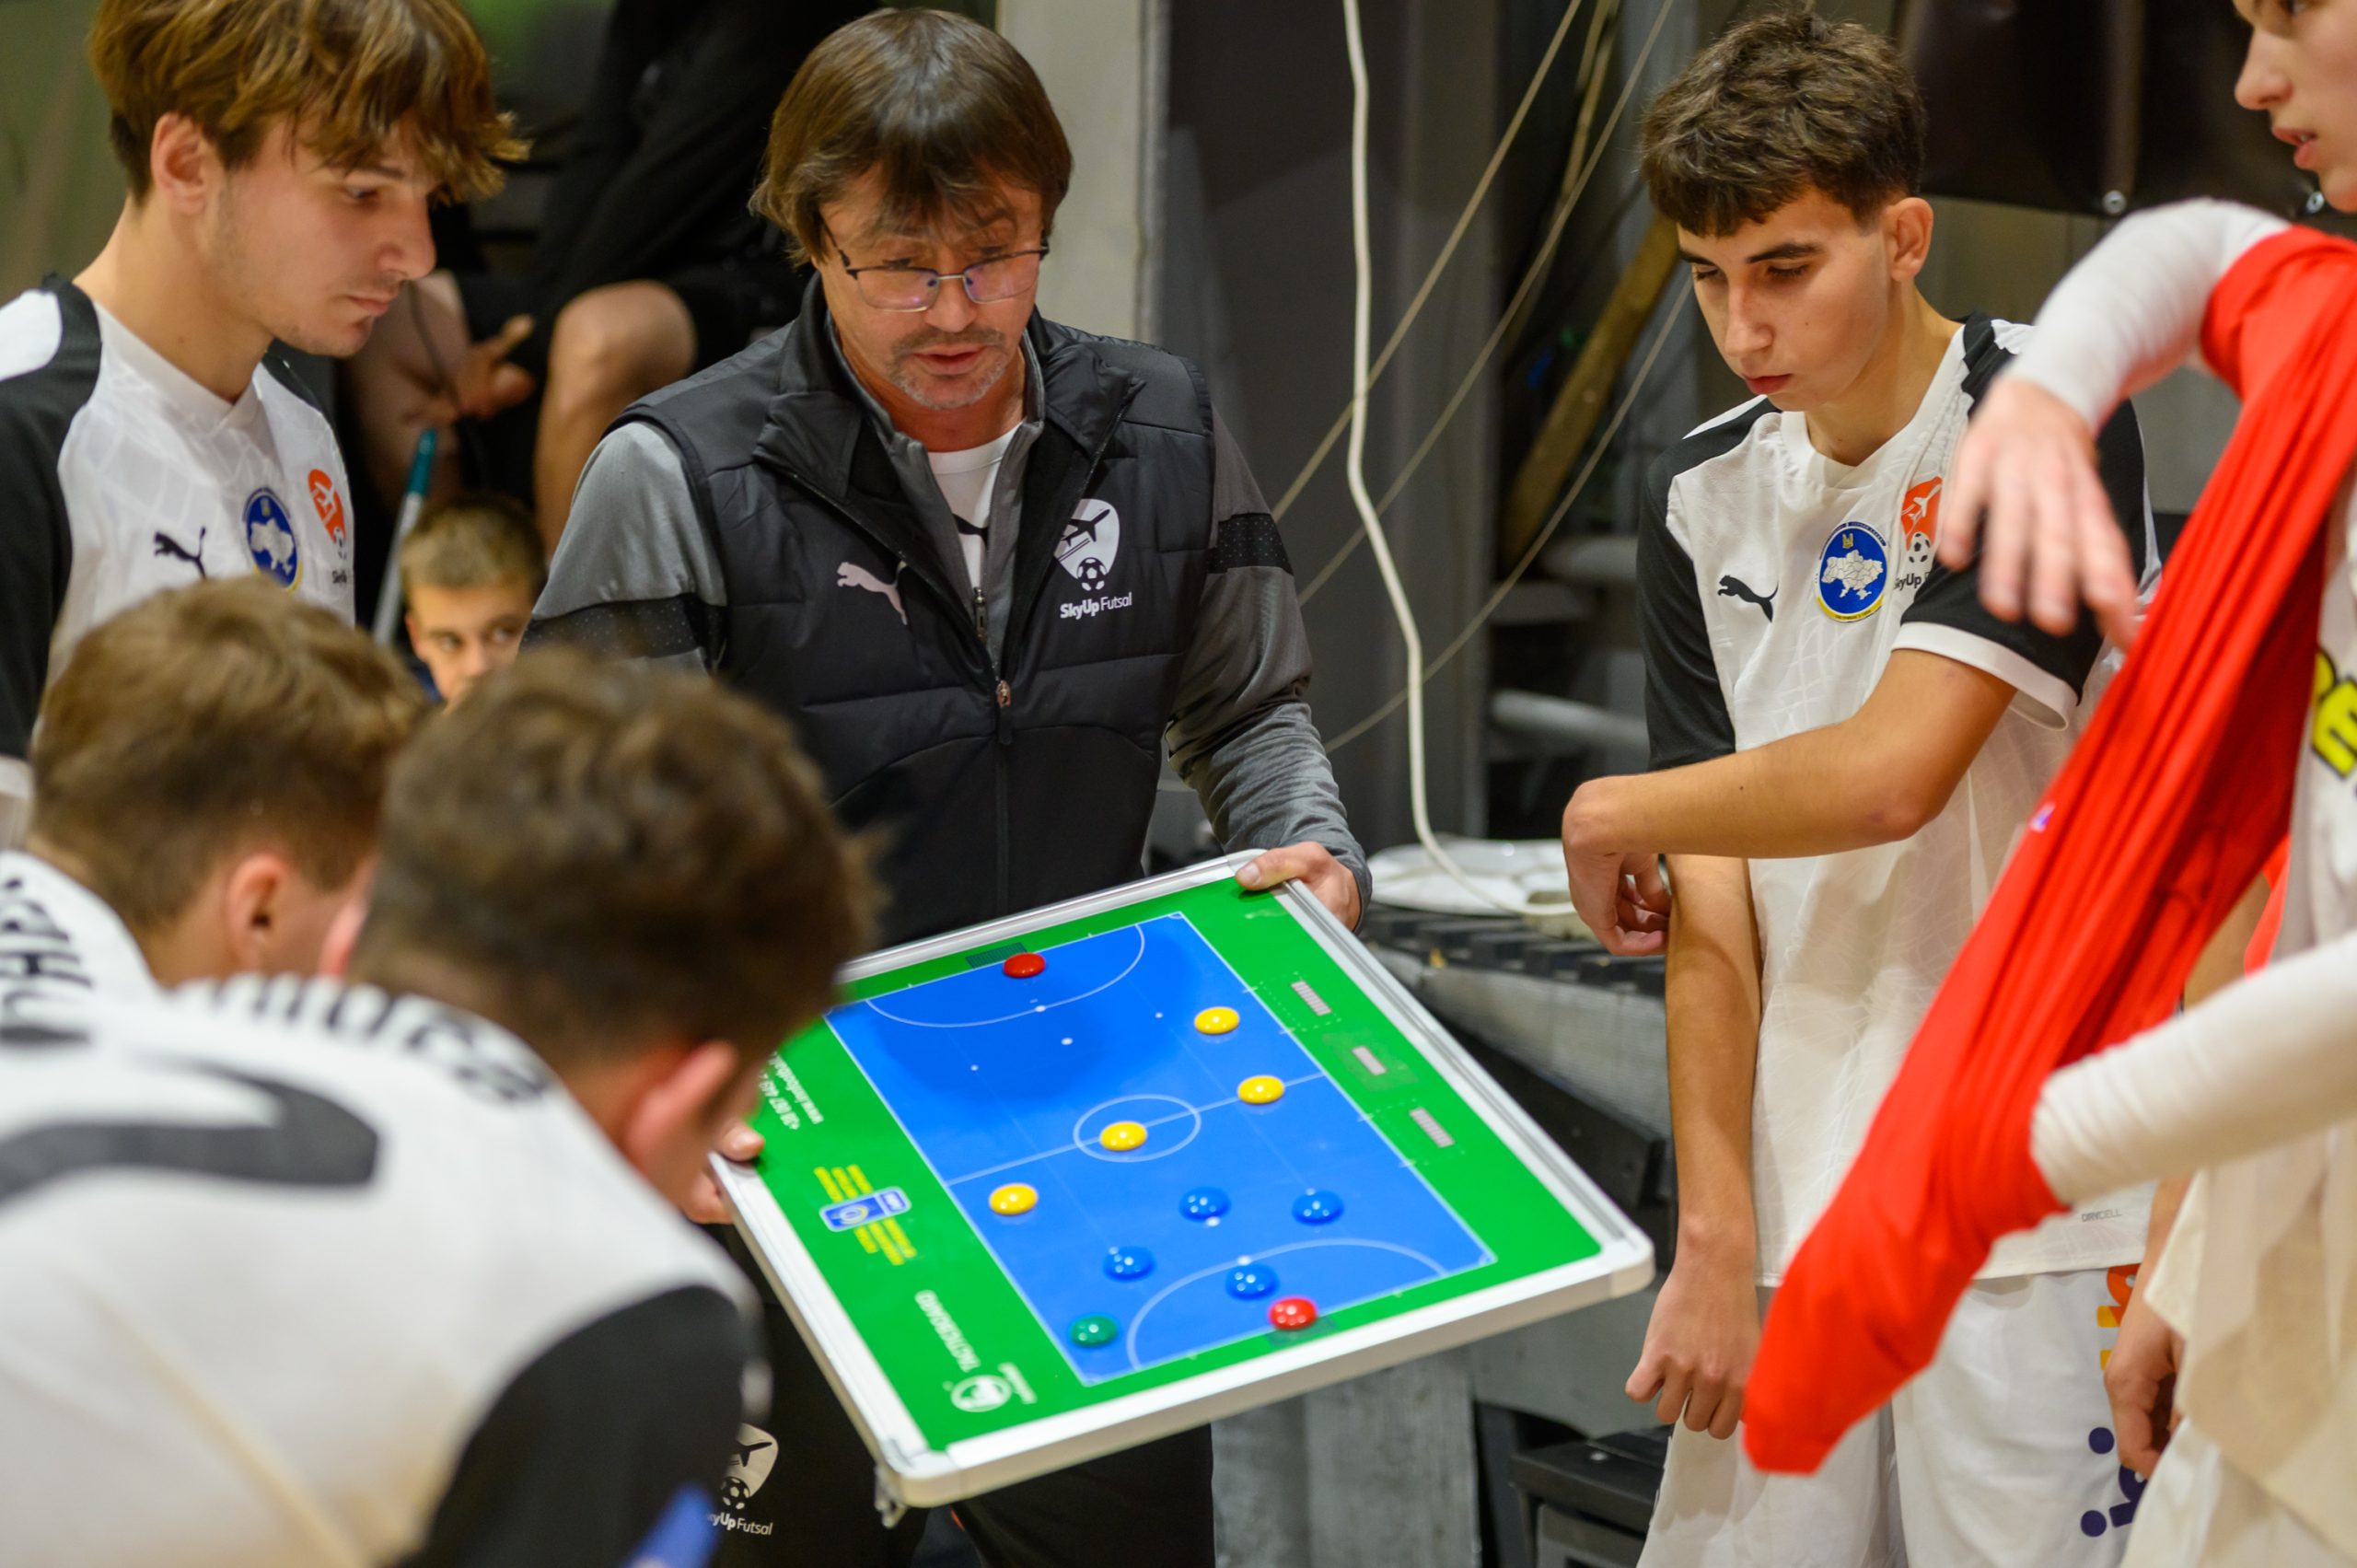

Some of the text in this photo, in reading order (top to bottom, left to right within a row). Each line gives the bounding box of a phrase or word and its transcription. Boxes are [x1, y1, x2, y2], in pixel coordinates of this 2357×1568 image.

[1060, 591, 1132, 620] SkyUp Futsal
[737, 1518, 773, 1536] Futsal
